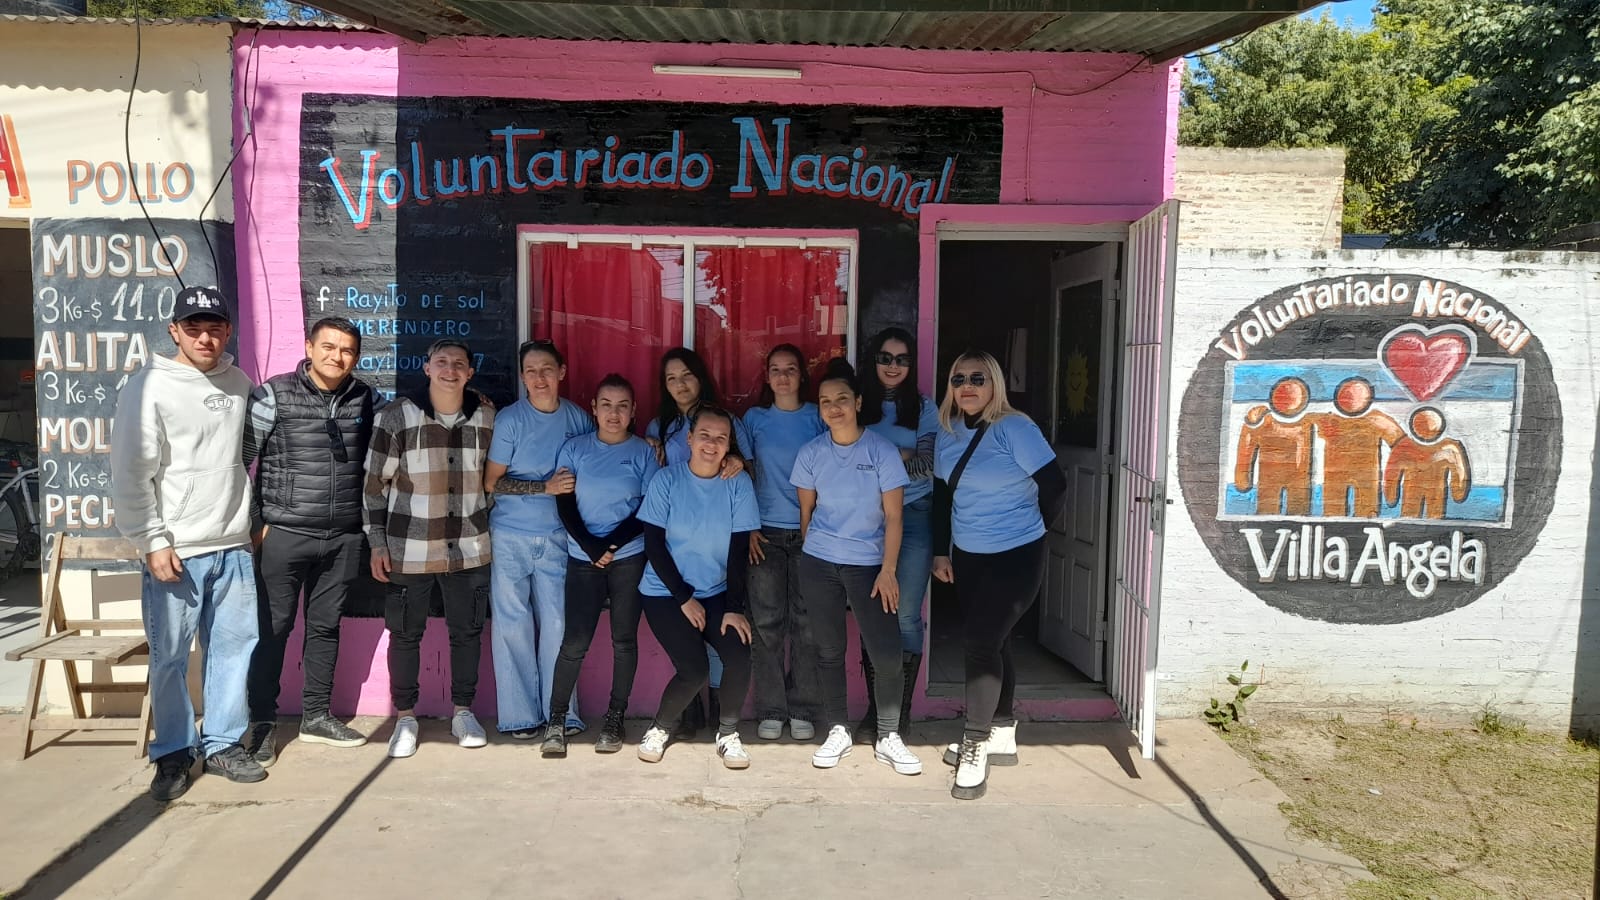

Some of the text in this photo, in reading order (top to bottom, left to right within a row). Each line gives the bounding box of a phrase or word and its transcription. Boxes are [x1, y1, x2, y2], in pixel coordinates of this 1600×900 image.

[67, 160, 195, 204] POLLO
[730, 116, 957, 220] Nacional
[41, 234, 188, 279] MUSLO
[196, 291, 211, 308] LA
[1214, 276, 1533, 360] Voluntariado Nacional
[36, 331, 150, 372] ALITA
[42, 371, 60, 401] 3
[40, 416, 115, 454] MOL
[43, 459, 61, 489] 2
[1239, 524, 1350, 582] Villa
